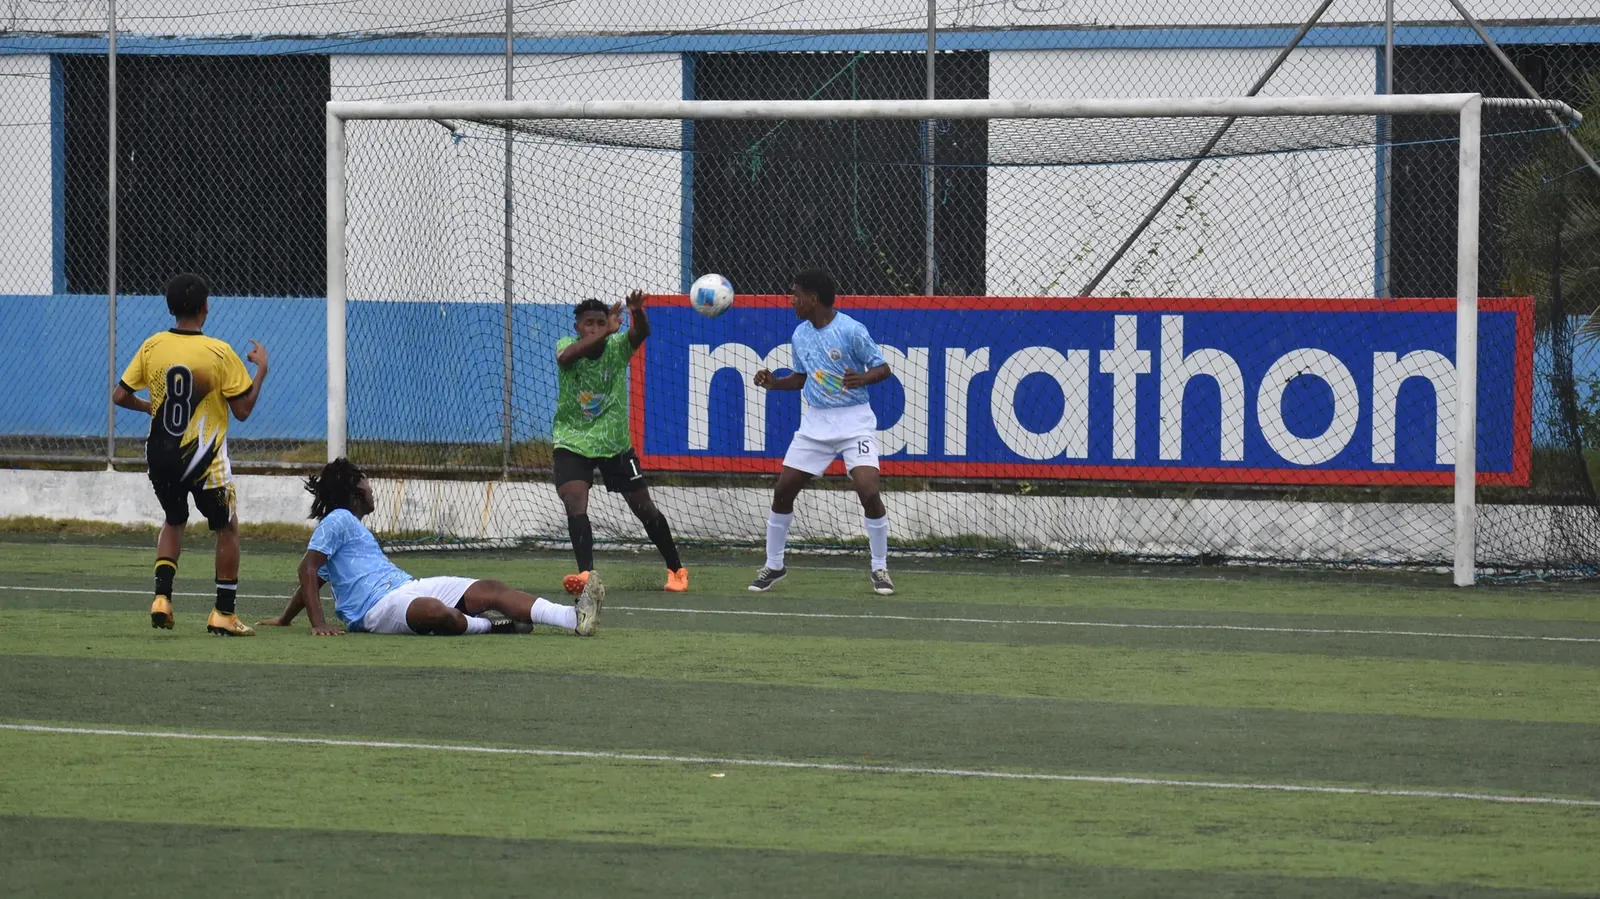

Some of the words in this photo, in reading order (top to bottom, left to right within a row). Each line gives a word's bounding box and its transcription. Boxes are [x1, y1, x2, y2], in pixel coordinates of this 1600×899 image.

[163, 364, 193, 436] 8
[857, 440, 870, 454] 15
[629, 458, 641, 479] 1
